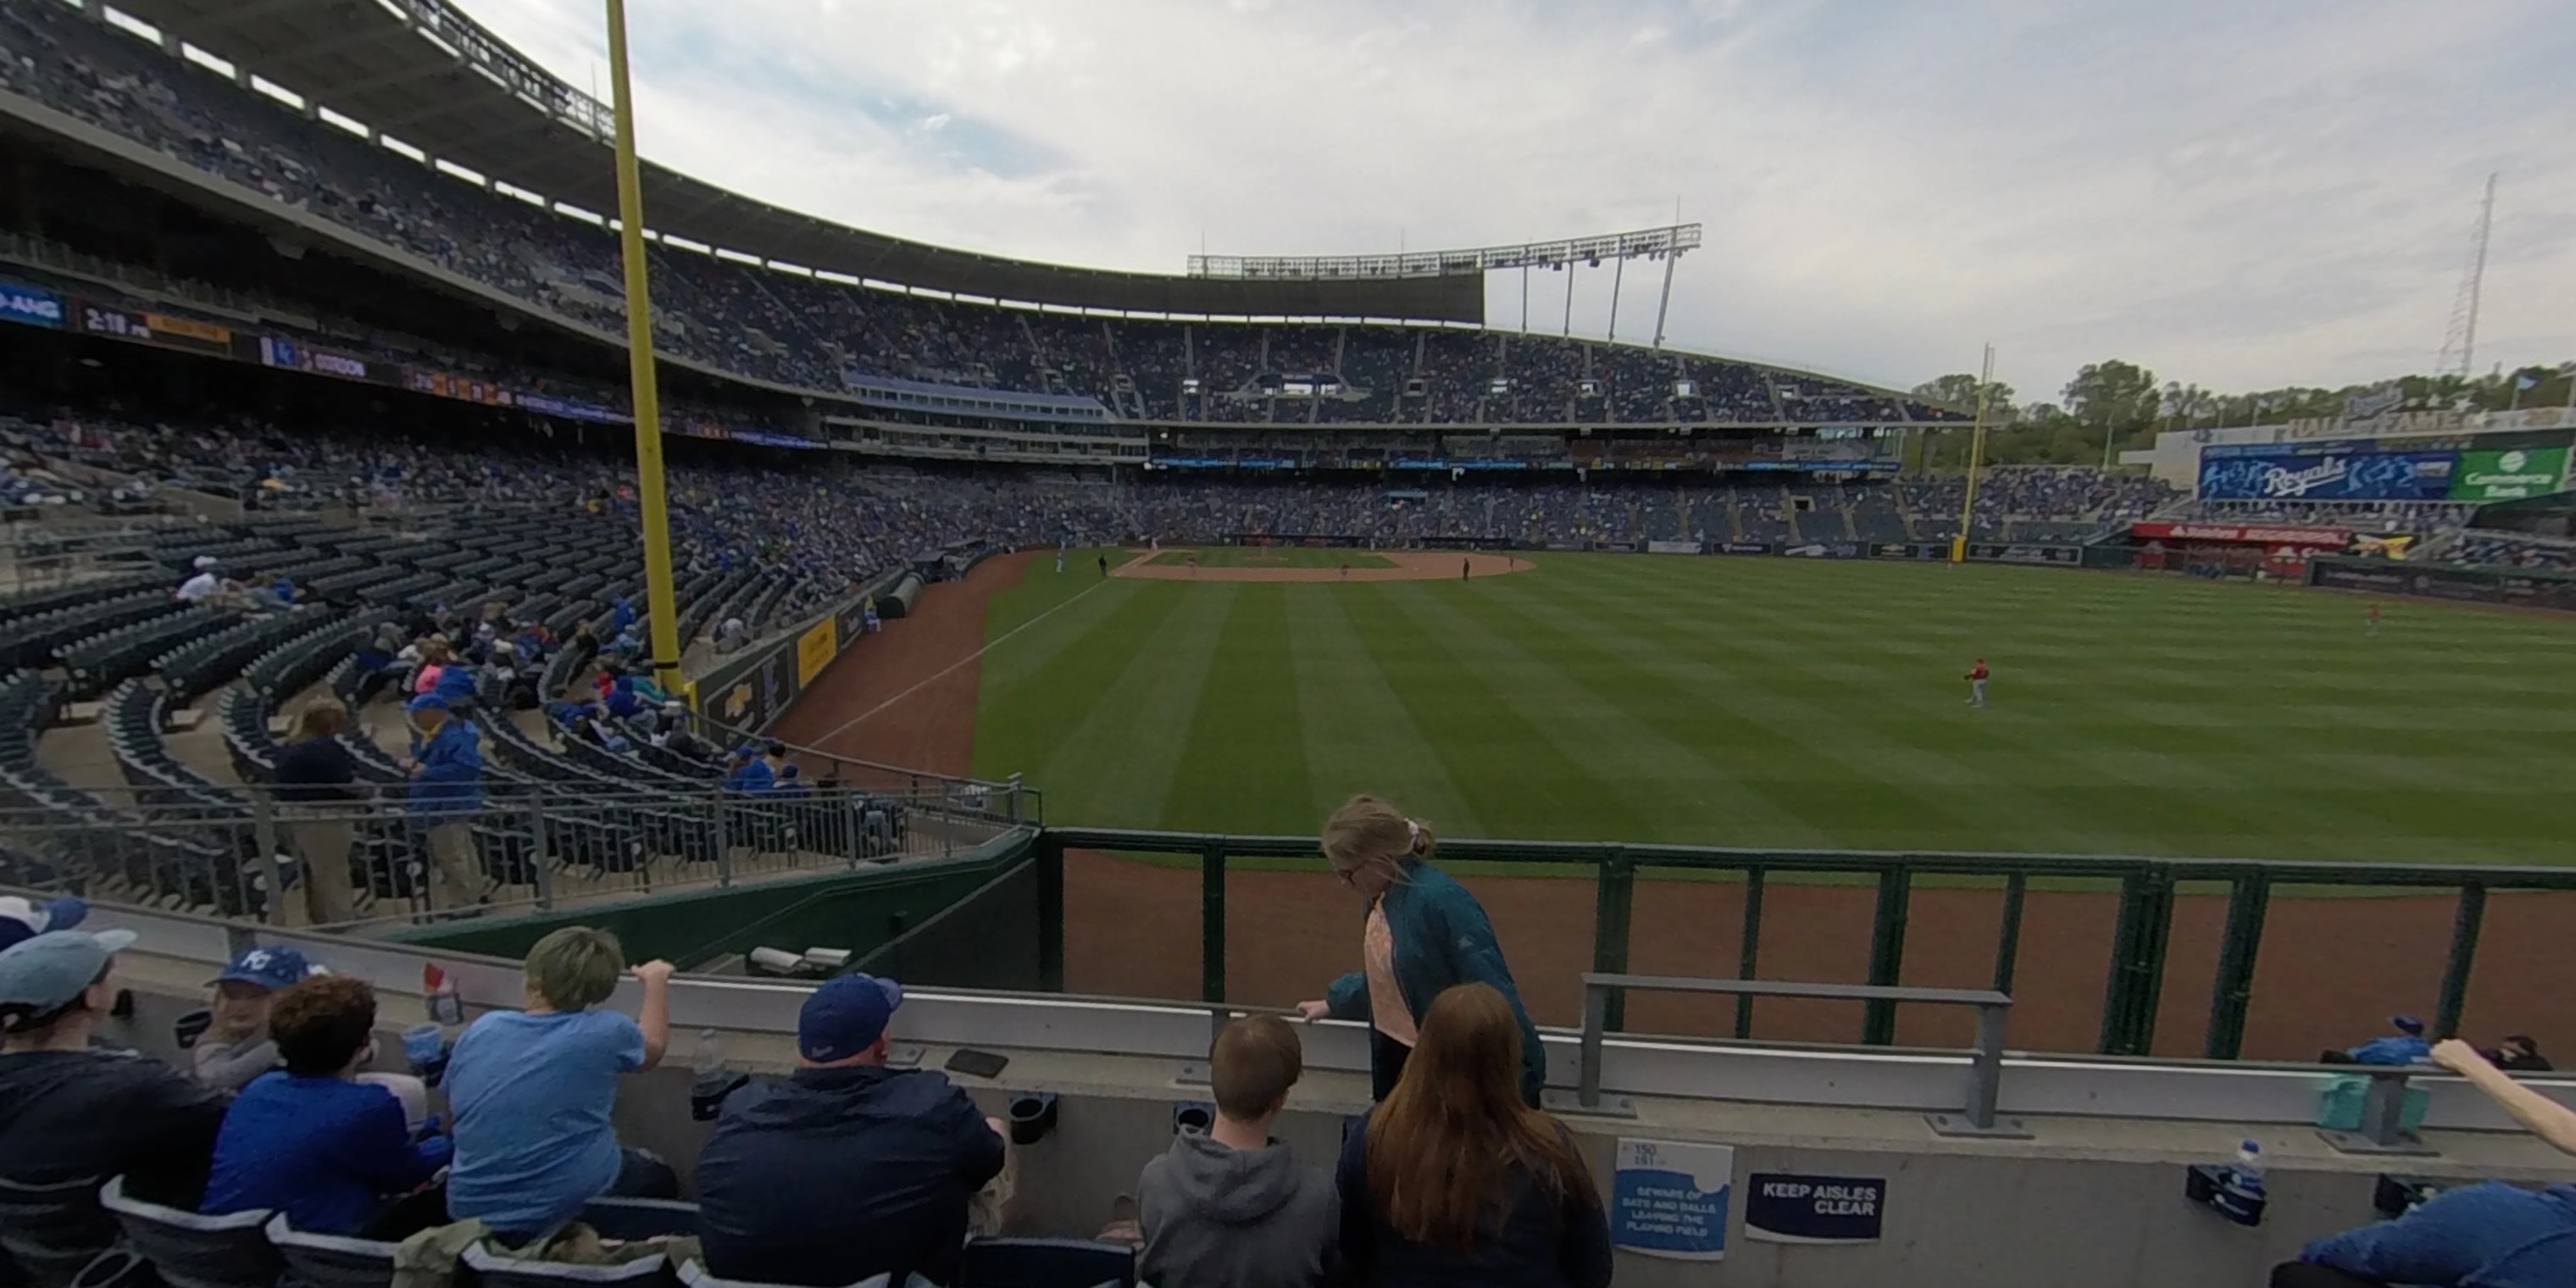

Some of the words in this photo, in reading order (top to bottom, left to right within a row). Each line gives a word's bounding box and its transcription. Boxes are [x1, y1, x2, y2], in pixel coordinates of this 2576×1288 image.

[2289, 415, 2351, 437] HALL
[2384, 410, 2462, 433] FAME
[2263, 456, 2346, 497] Royals
[1763, 1183, 1811, 1198] KEEP
[1813, 1185, 1877, 1201] AISLES
[1653, 1200, 1678, 1211] AND
[1814, 1200, 1875, 1216] CLEAR
